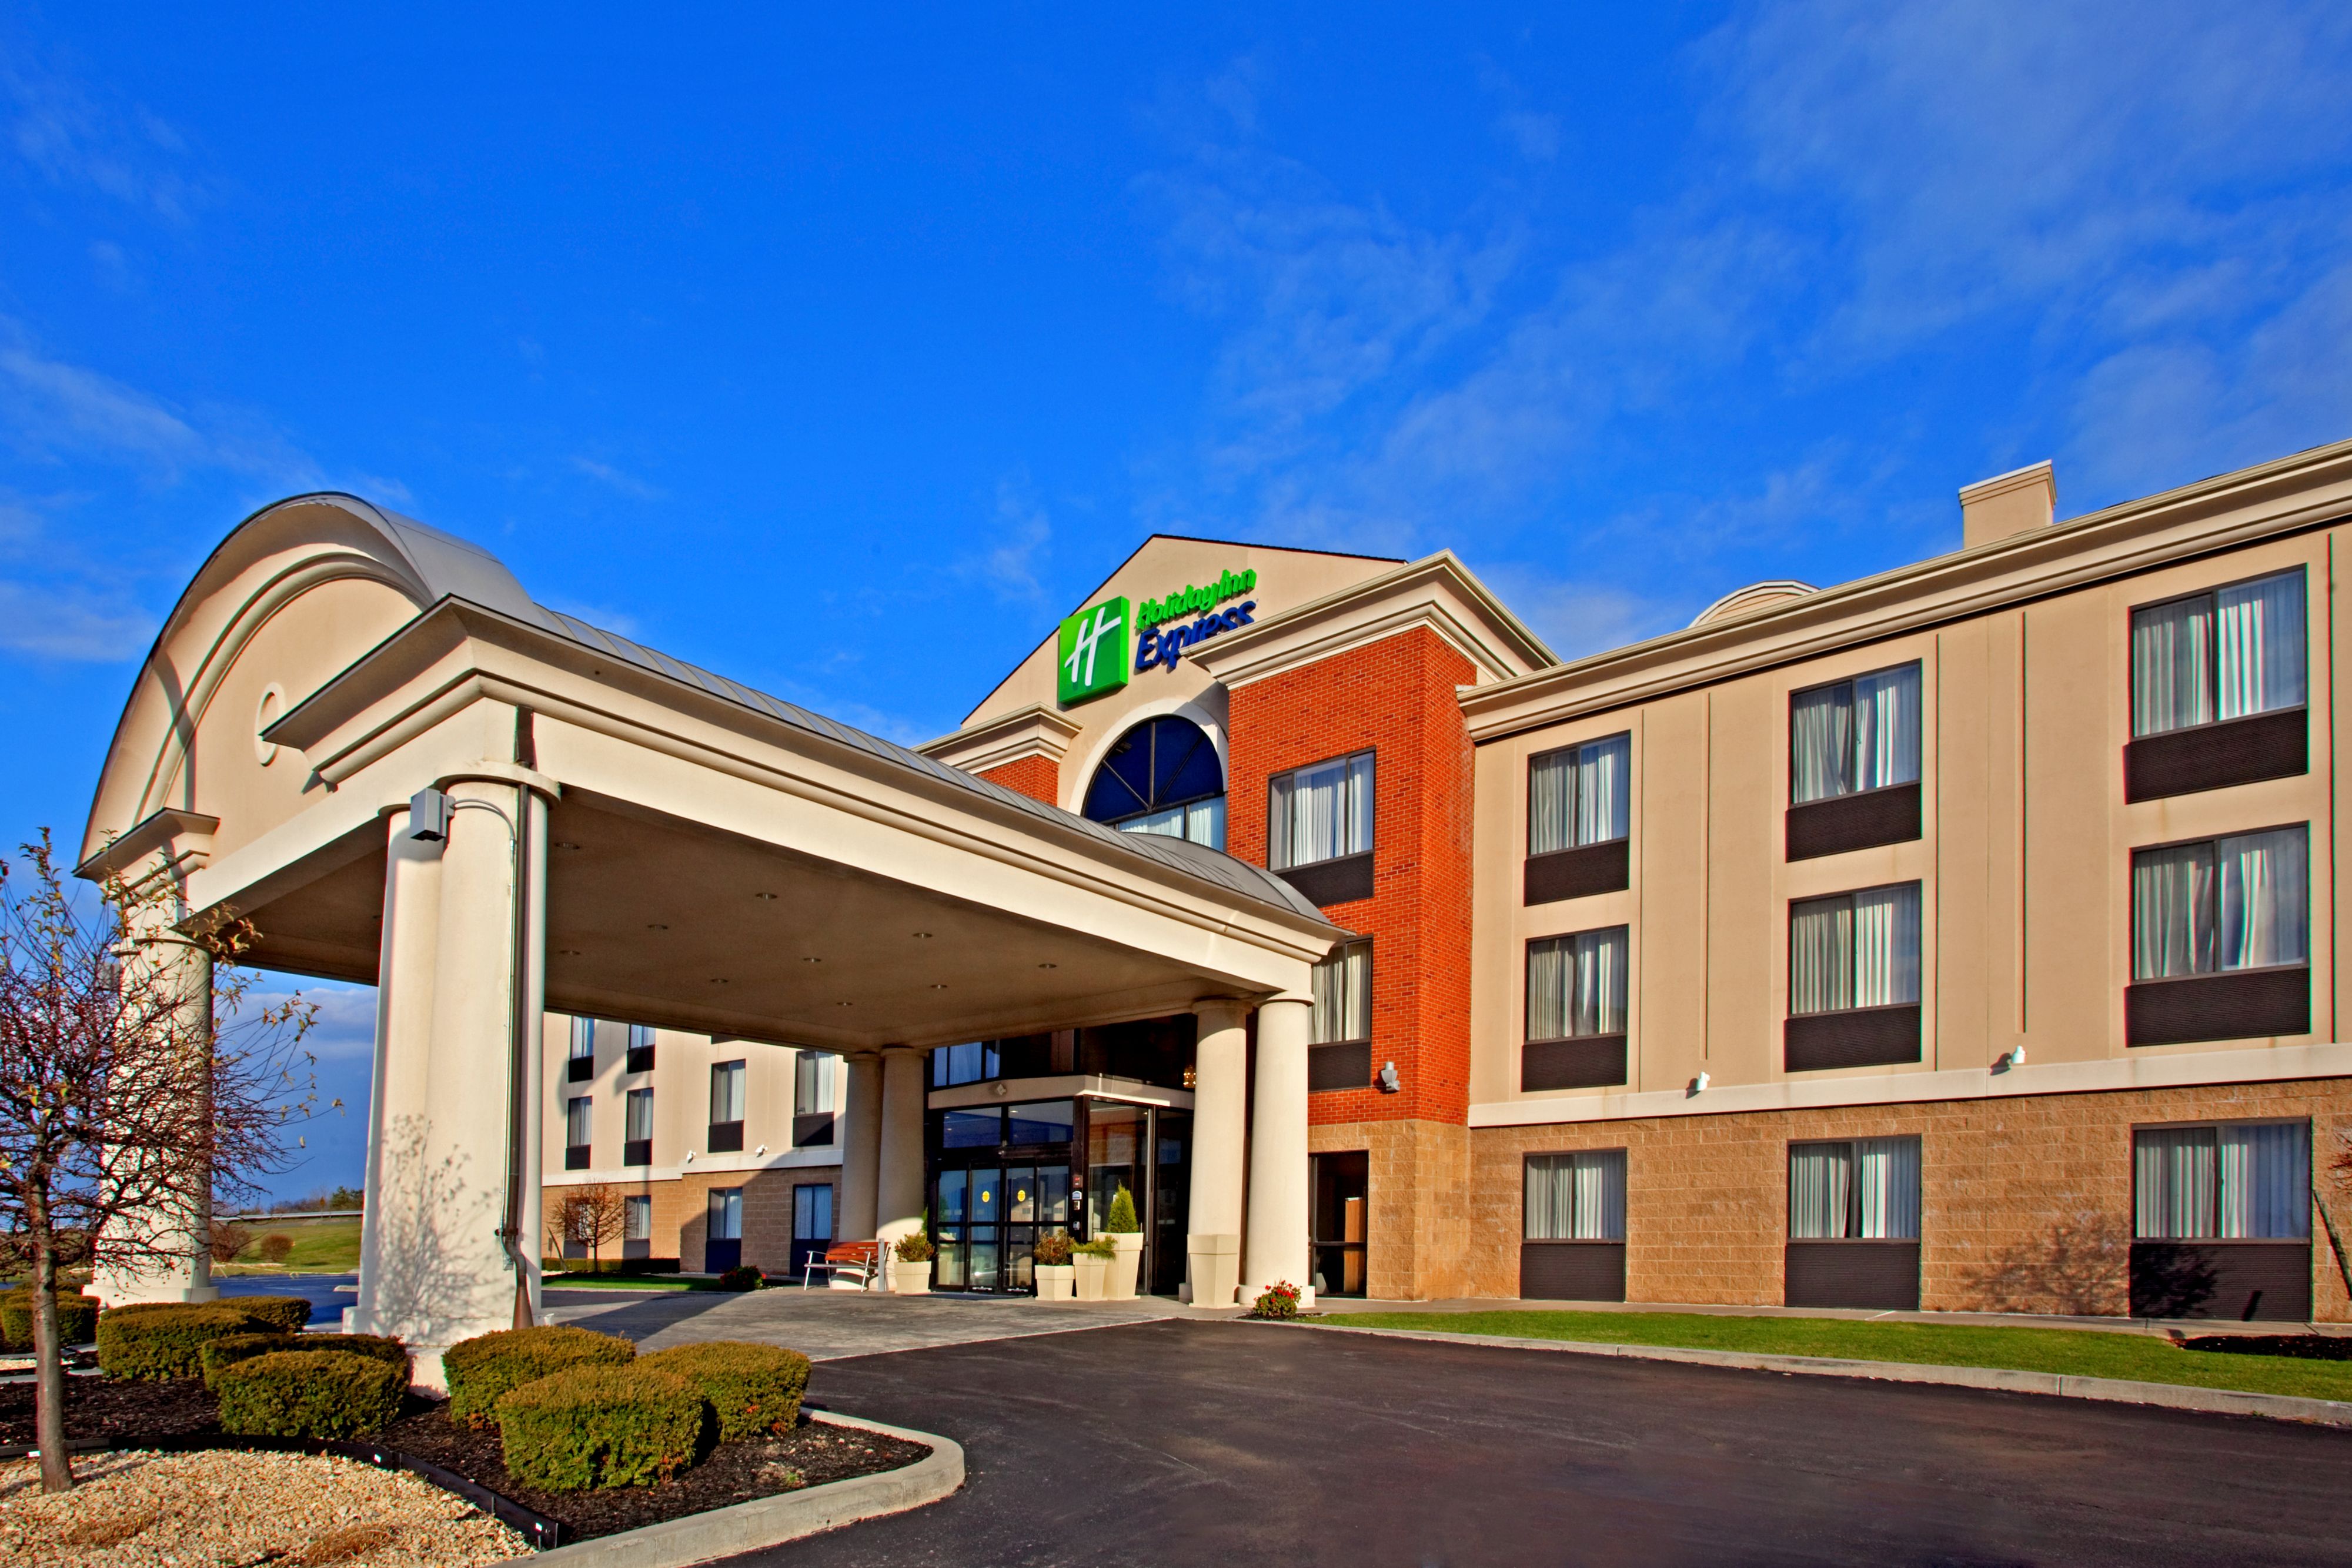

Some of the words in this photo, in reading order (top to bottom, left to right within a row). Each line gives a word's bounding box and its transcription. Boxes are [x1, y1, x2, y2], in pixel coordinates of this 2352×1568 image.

[1136, 583, 1220, 630] Holiday
[1218, 569, 1257, 599] Inn
[1135, 601, 1257, 670] Express
